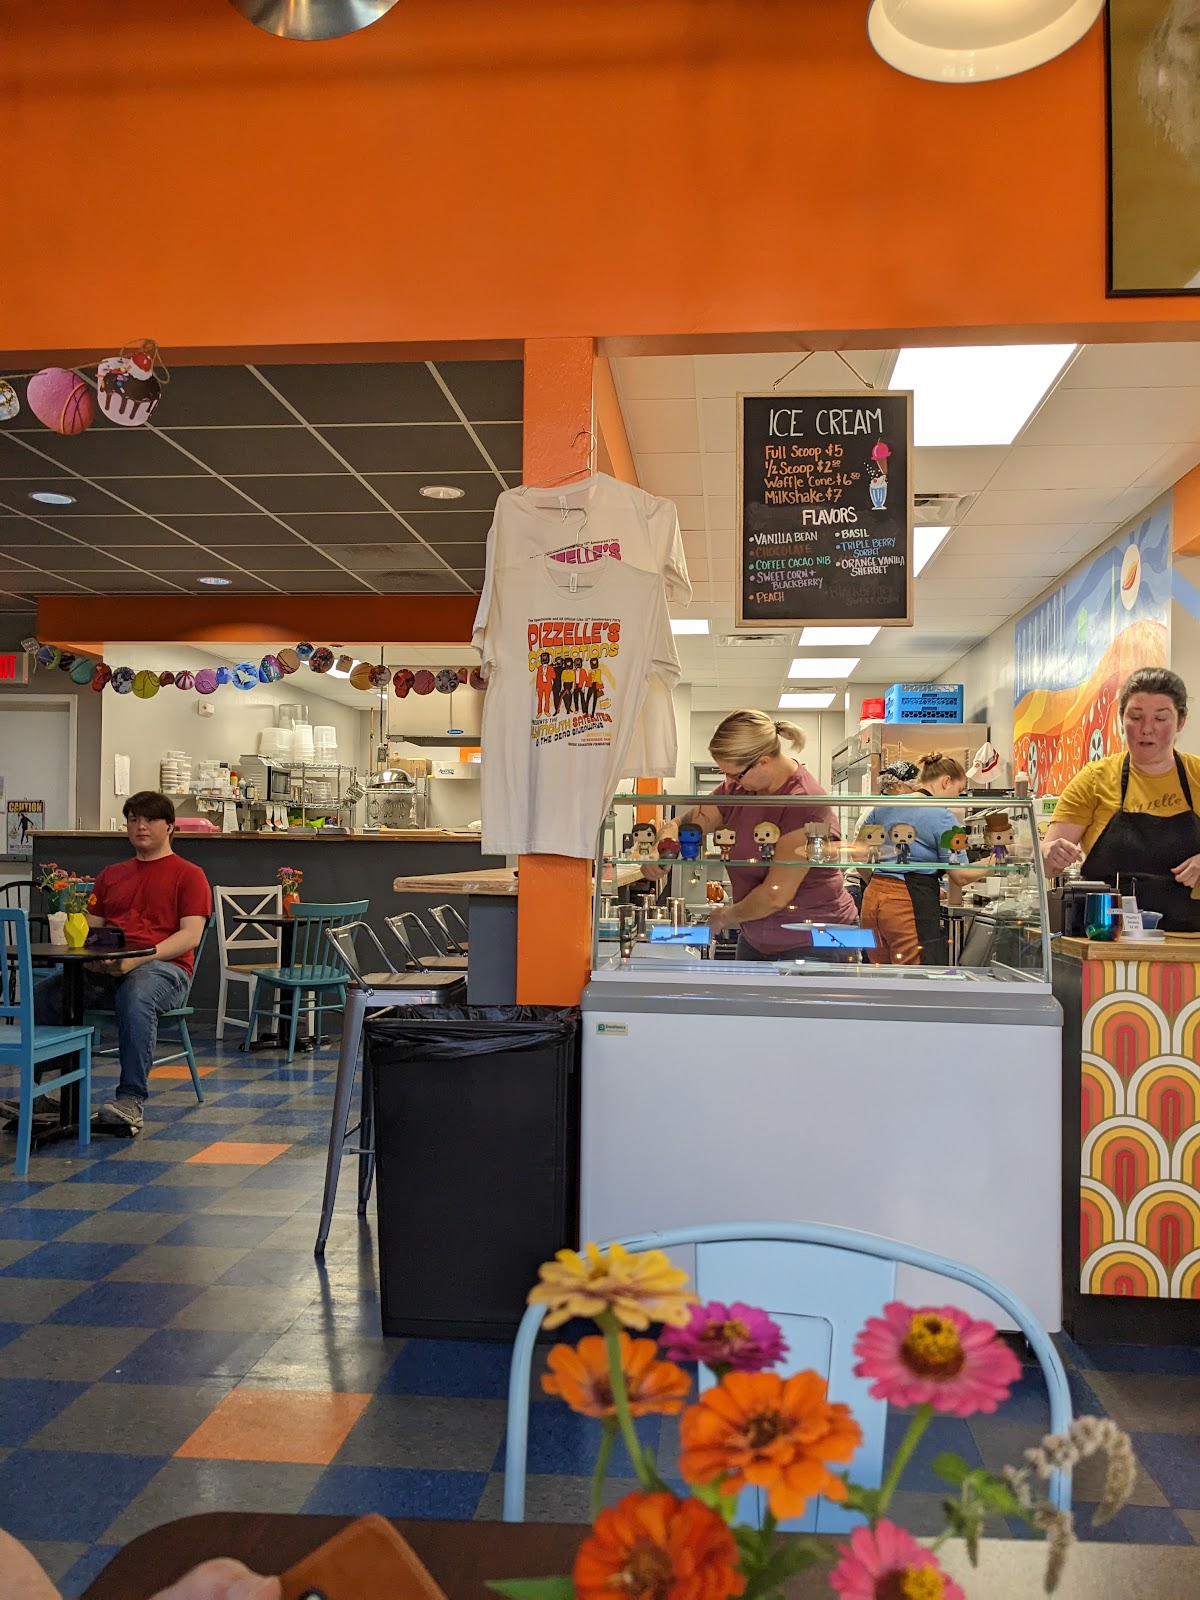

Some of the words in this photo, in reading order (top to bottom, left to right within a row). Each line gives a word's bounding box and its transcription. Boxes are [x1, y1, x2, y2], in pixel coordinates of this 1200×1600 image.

[768, 408, 804, 436] ICE
[816, 408, 882, 436] CREAM
[765, 445, 786, 460] Full
[790, 444, 822, 462] Scoop
[826, 444, 844, 457] $5
[780, 462, 814, 478] Scoop
[764, 475, 804, 490] Waffle
[808, 476, 835, 487] Cone
[764, 488, 826, 504] Milkshake
[826, 487, 842, 502] $7
[802, 506, 858, 526] FLAVORS
[754, 532, 792, 545] VANILLA
[794, 531, 818, 542] BEAN
[841, 528, 870, 538] BASIL
[840, 540, 870, 551] TRIPLE
[872, 537, 896, 548] BERRY
[853, 548, 880, 558] SORBET
[756, 560, 786, 570] COFFEE
[788, 558, 814, 568] CACAO
[816, 556, 832, 564] NIB
[842, 556, 876, 569] ORANGE
[756, 570, 785, 583] SWEET
[786, 569, 808, 580] CORN
[850, 565, 888, 576] SHERBET
[771, 578, 823, 590] BLACKBERRY
[756, 592, 784, 603] PEACH
[528, 622, 620, 651] PIZZELLE'S
[554, 730, 571, 741] DEAD
[8, 802, 42, 812] CAUTION
